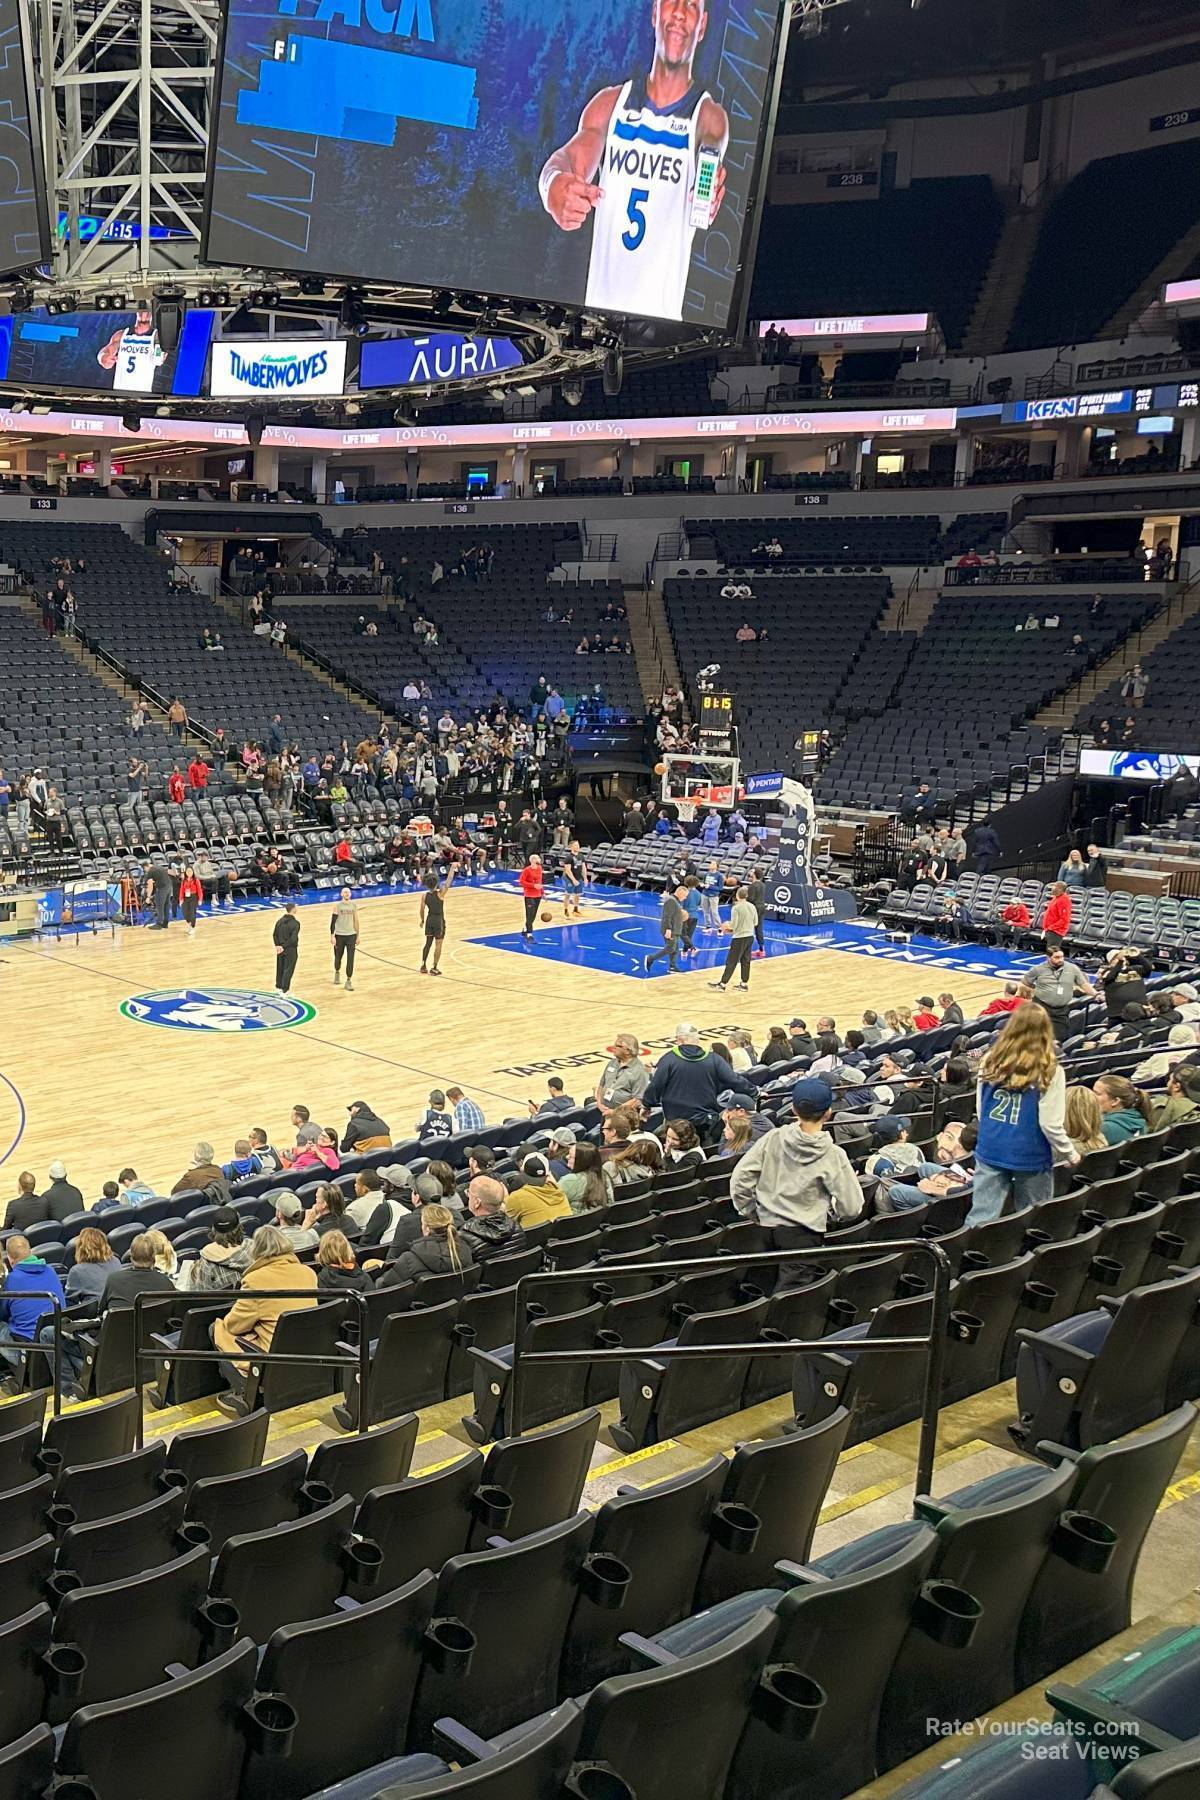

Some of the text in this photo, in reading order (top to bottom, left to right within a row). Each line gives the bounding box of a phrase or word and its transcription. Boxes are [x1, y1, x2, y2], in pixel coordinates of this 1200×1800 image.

[1164, 112, 1189, 128] 239
[609, 146, 682, 184] WOLVES
[840, 174, 863, 186] 238
[621, 187, 650, 251] 5
[119, 344, 149, 355] WOLVES
[126, 356, 137, 374] 5
[229, 349, 328, 390] TIMBERWOLVES
[1026, 397, 1077, 421] KFAN
[37, 500, 51, 509] 133
[803, 495, 820, 504] 138
[452, 504, 467, 514] 136
[755, 777, 782, 788] PENTAIR
[809, 899, 834, 909] TARGET
[810, 907, 835, 917] CENTER
[493, 1051, 613, 1078] TARGET
[989, 1088, 1022, 1126] 21
